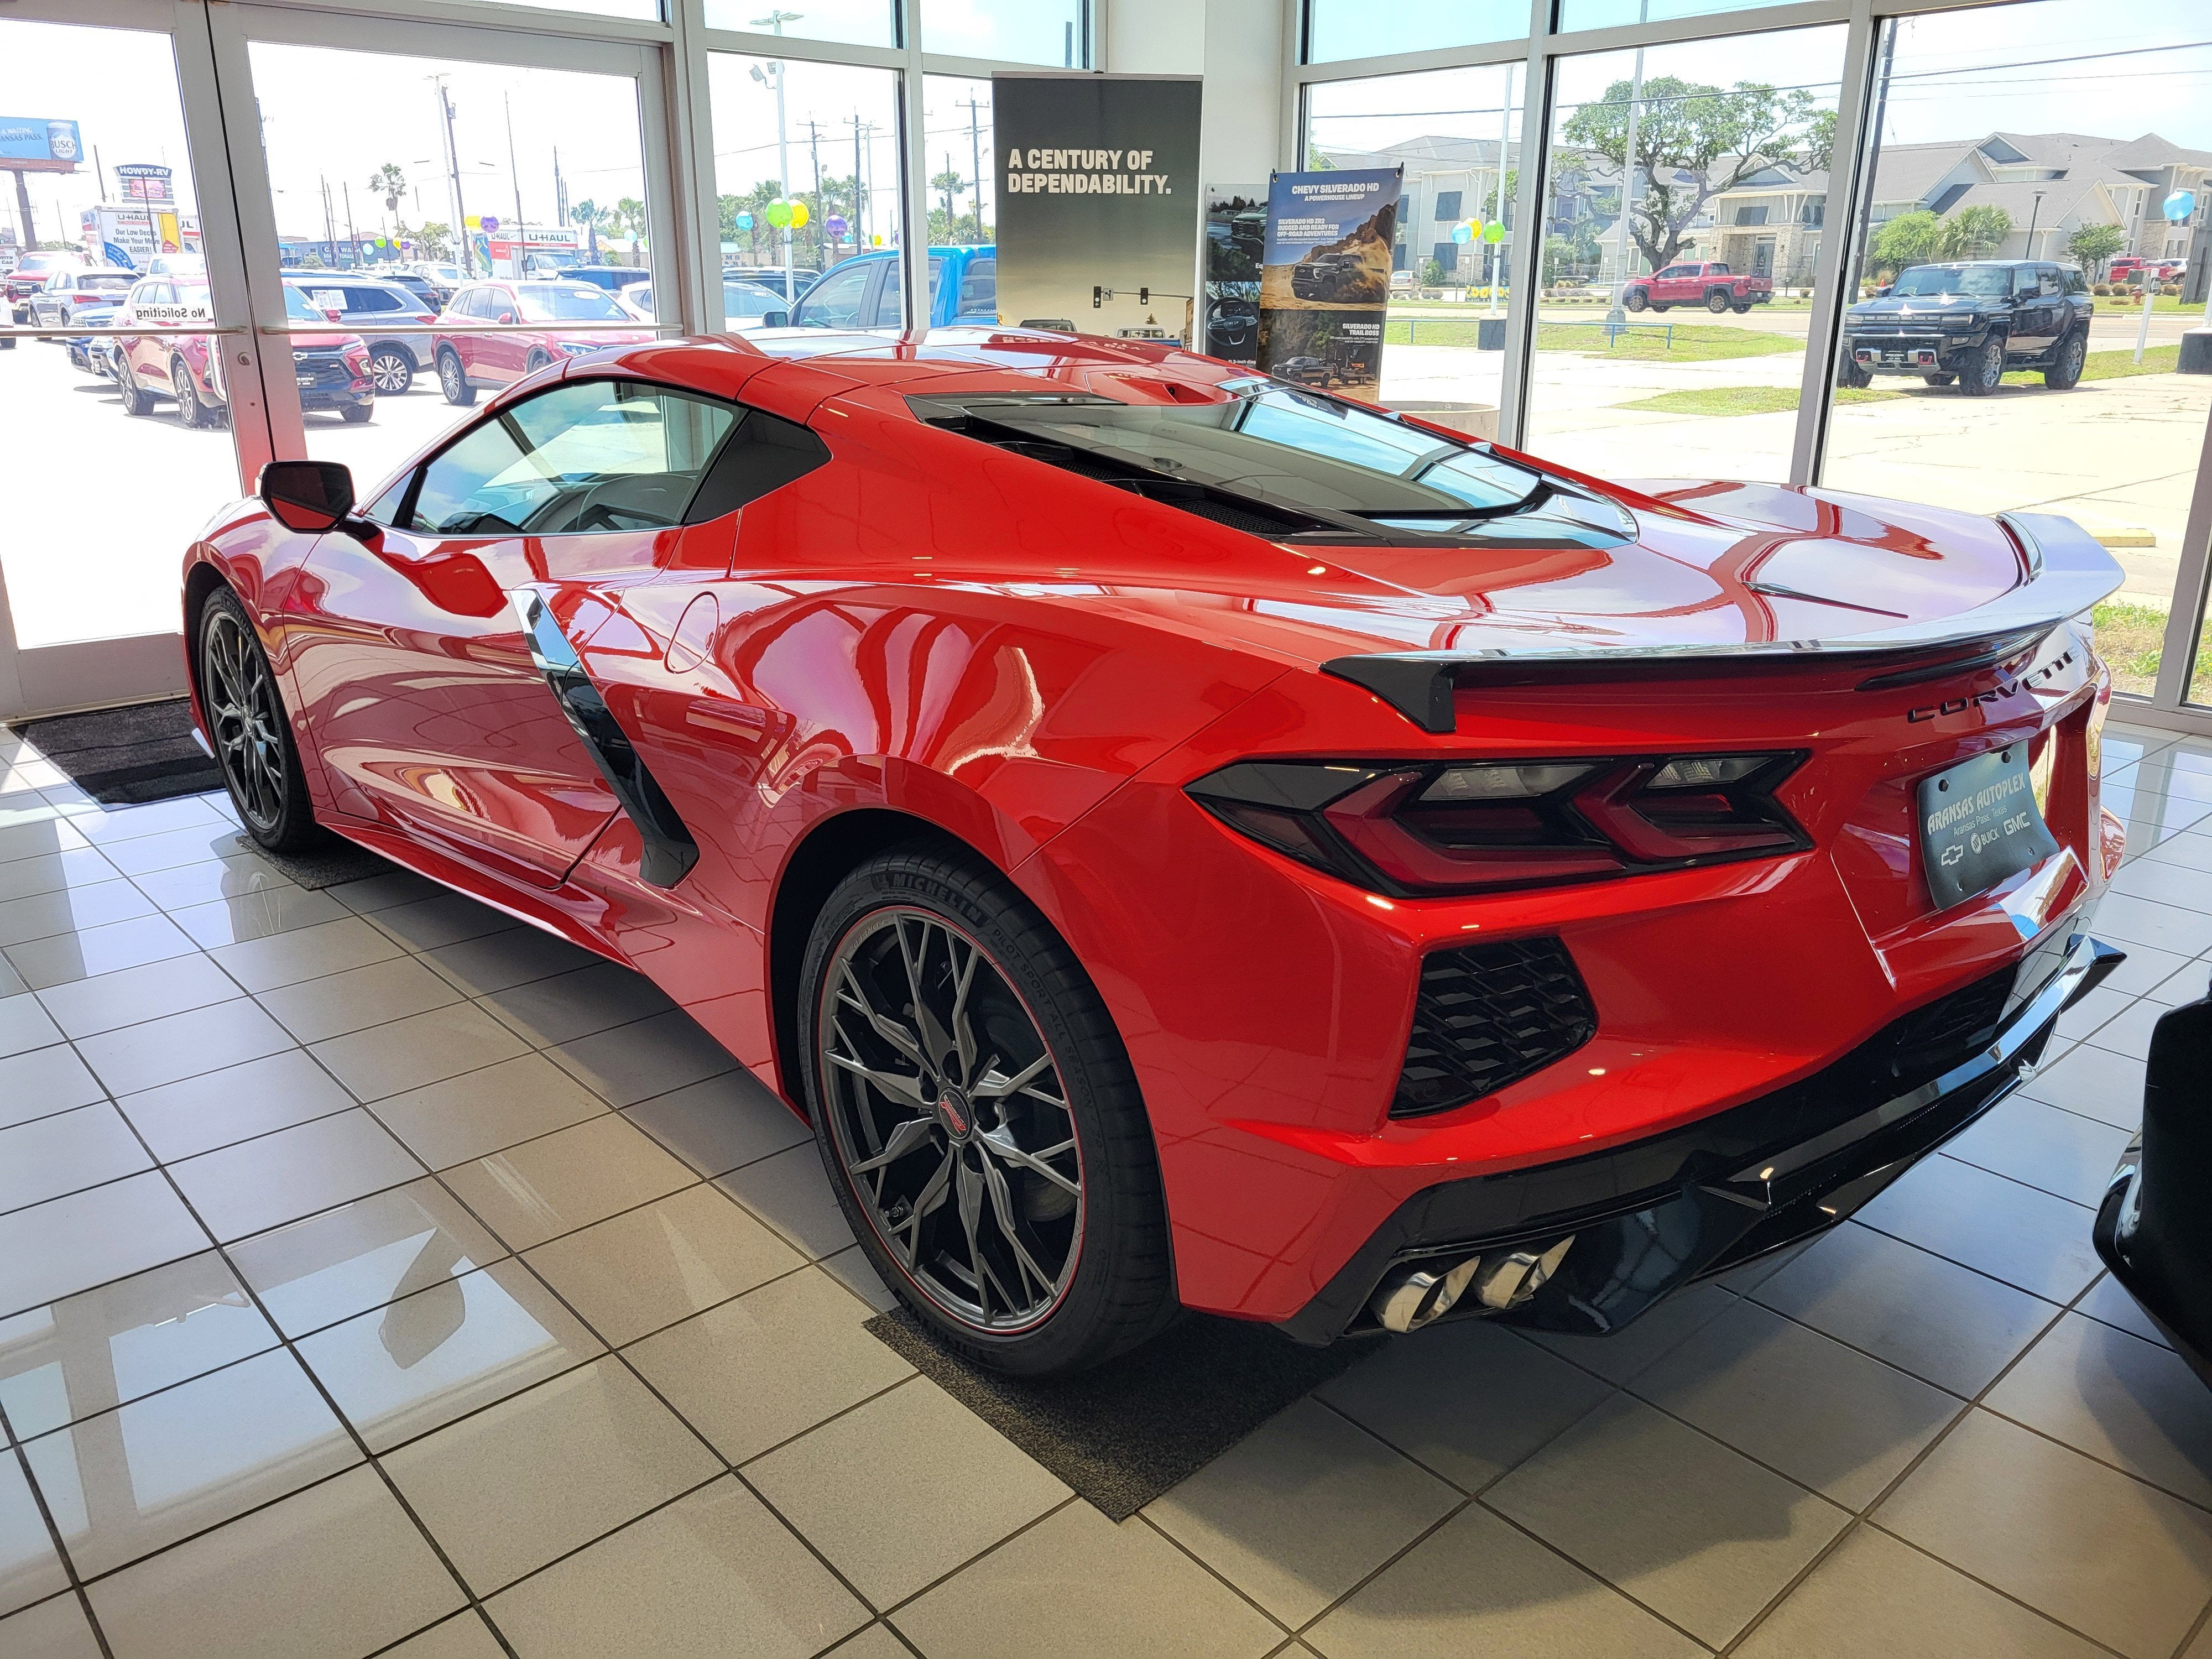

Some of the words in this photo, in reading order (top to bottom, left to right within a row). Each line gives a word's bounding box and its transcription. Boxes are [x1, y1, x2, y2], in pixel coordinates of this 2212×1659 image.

[50, 140, 76, 149] BUSCH
[1008, 149, 1023, 169] A
[1027, 149, 1123, 170] CENTURY
[1126, 150, 1153, 170] OF
[119, 166, 169, 176] HOWDY-RV
[1008, 173, 1171, 194] DEPENDABILITY.
[1292, 185, 1320, 194] CHEVY
[1320, 184, 1365, 194] SILVERADO
[1366, 182, 1379, 192] HD
[1907, 645, 2079, 724] CORVETTE
[1927, 795, 1974, 836] ARANSAS
[1976, 772, 2026, 812] AUTOPLEX
[1954, 820, 1976, 837] Aransas
[1992, 805, 2007, 818] Texas
[1981, 827, 2000, 846] BUICK
[2003, 811, 2031, 836] GMC
[893, 873, 983, 923] MICHELIN
[993, 928, 1021, 962] PILOT
[1021, 963, 1052, 1006] SPORT
[1050, 1013, 1066, 1041] ALL
[1065, 1046, 1094, 1110] SEASON
